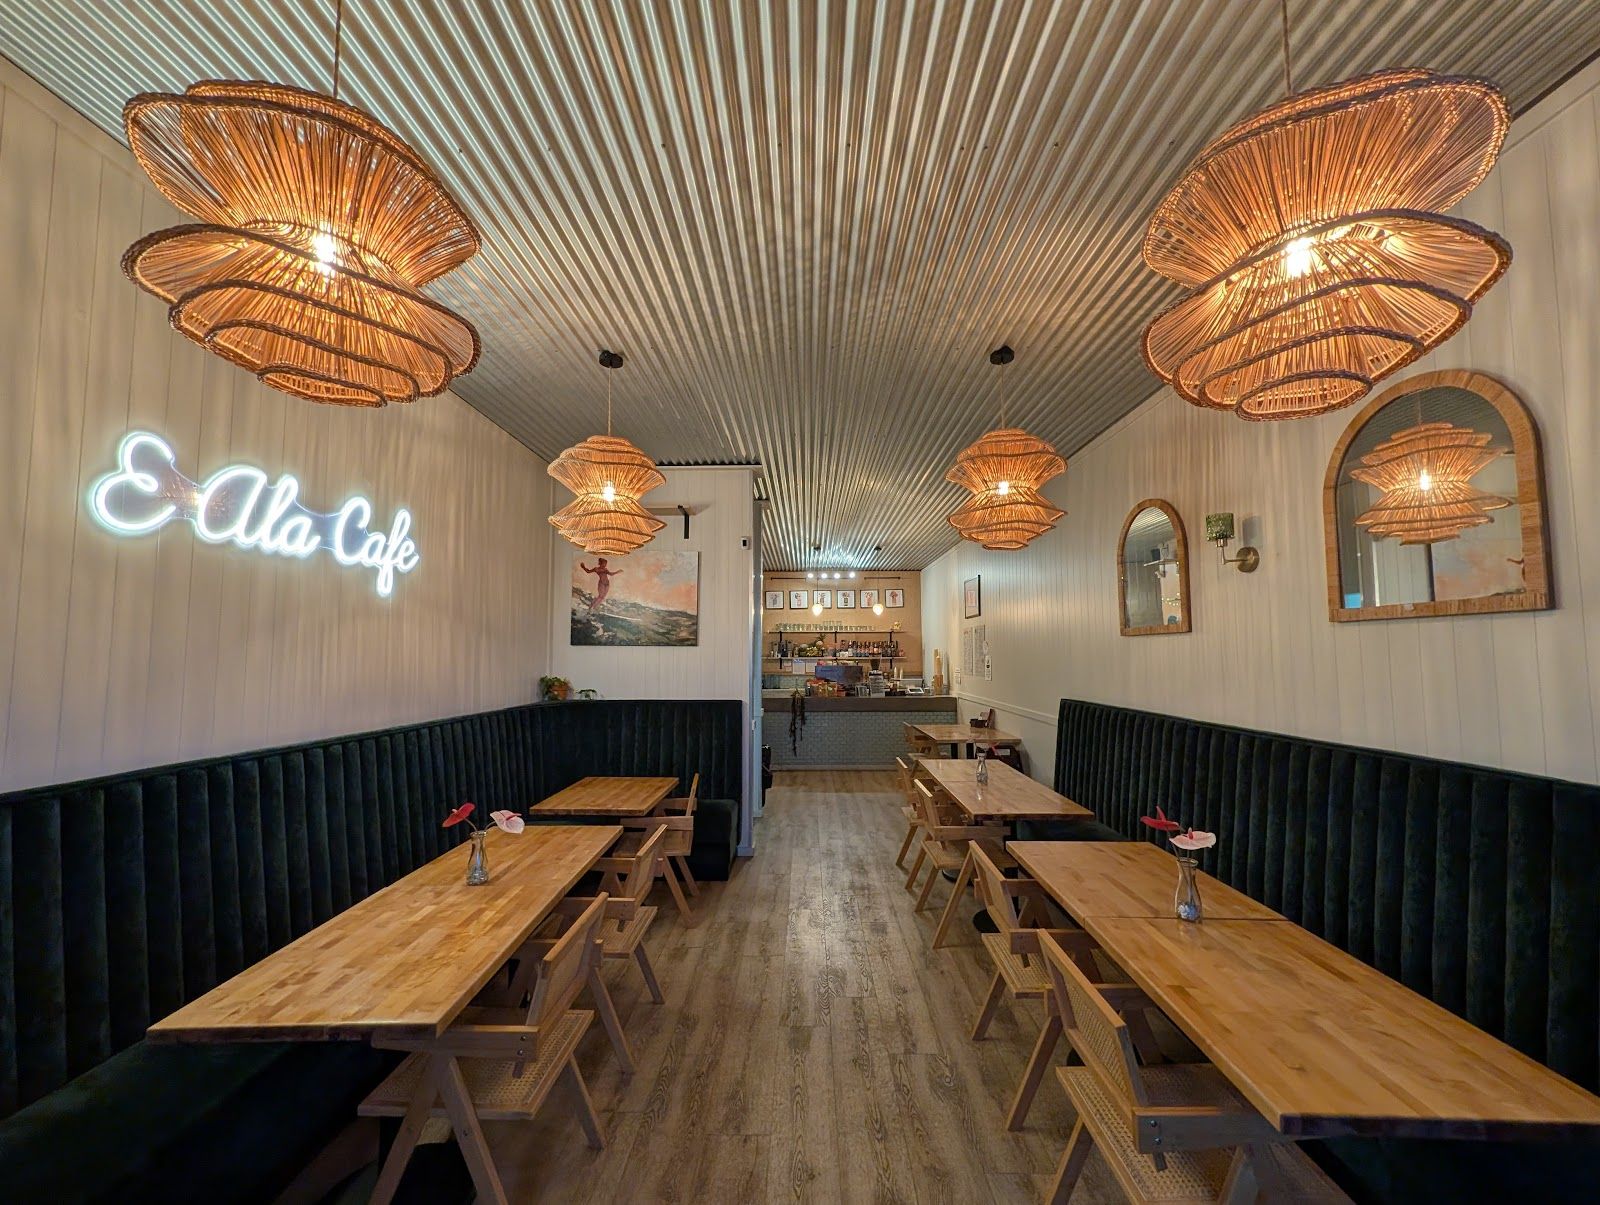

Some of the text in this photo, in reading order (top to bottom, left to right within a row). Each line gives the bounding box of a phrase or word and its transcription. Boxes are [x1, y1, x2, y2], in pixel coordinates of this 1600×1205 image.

[93, 431, 420, 596] E Ala Cafe
